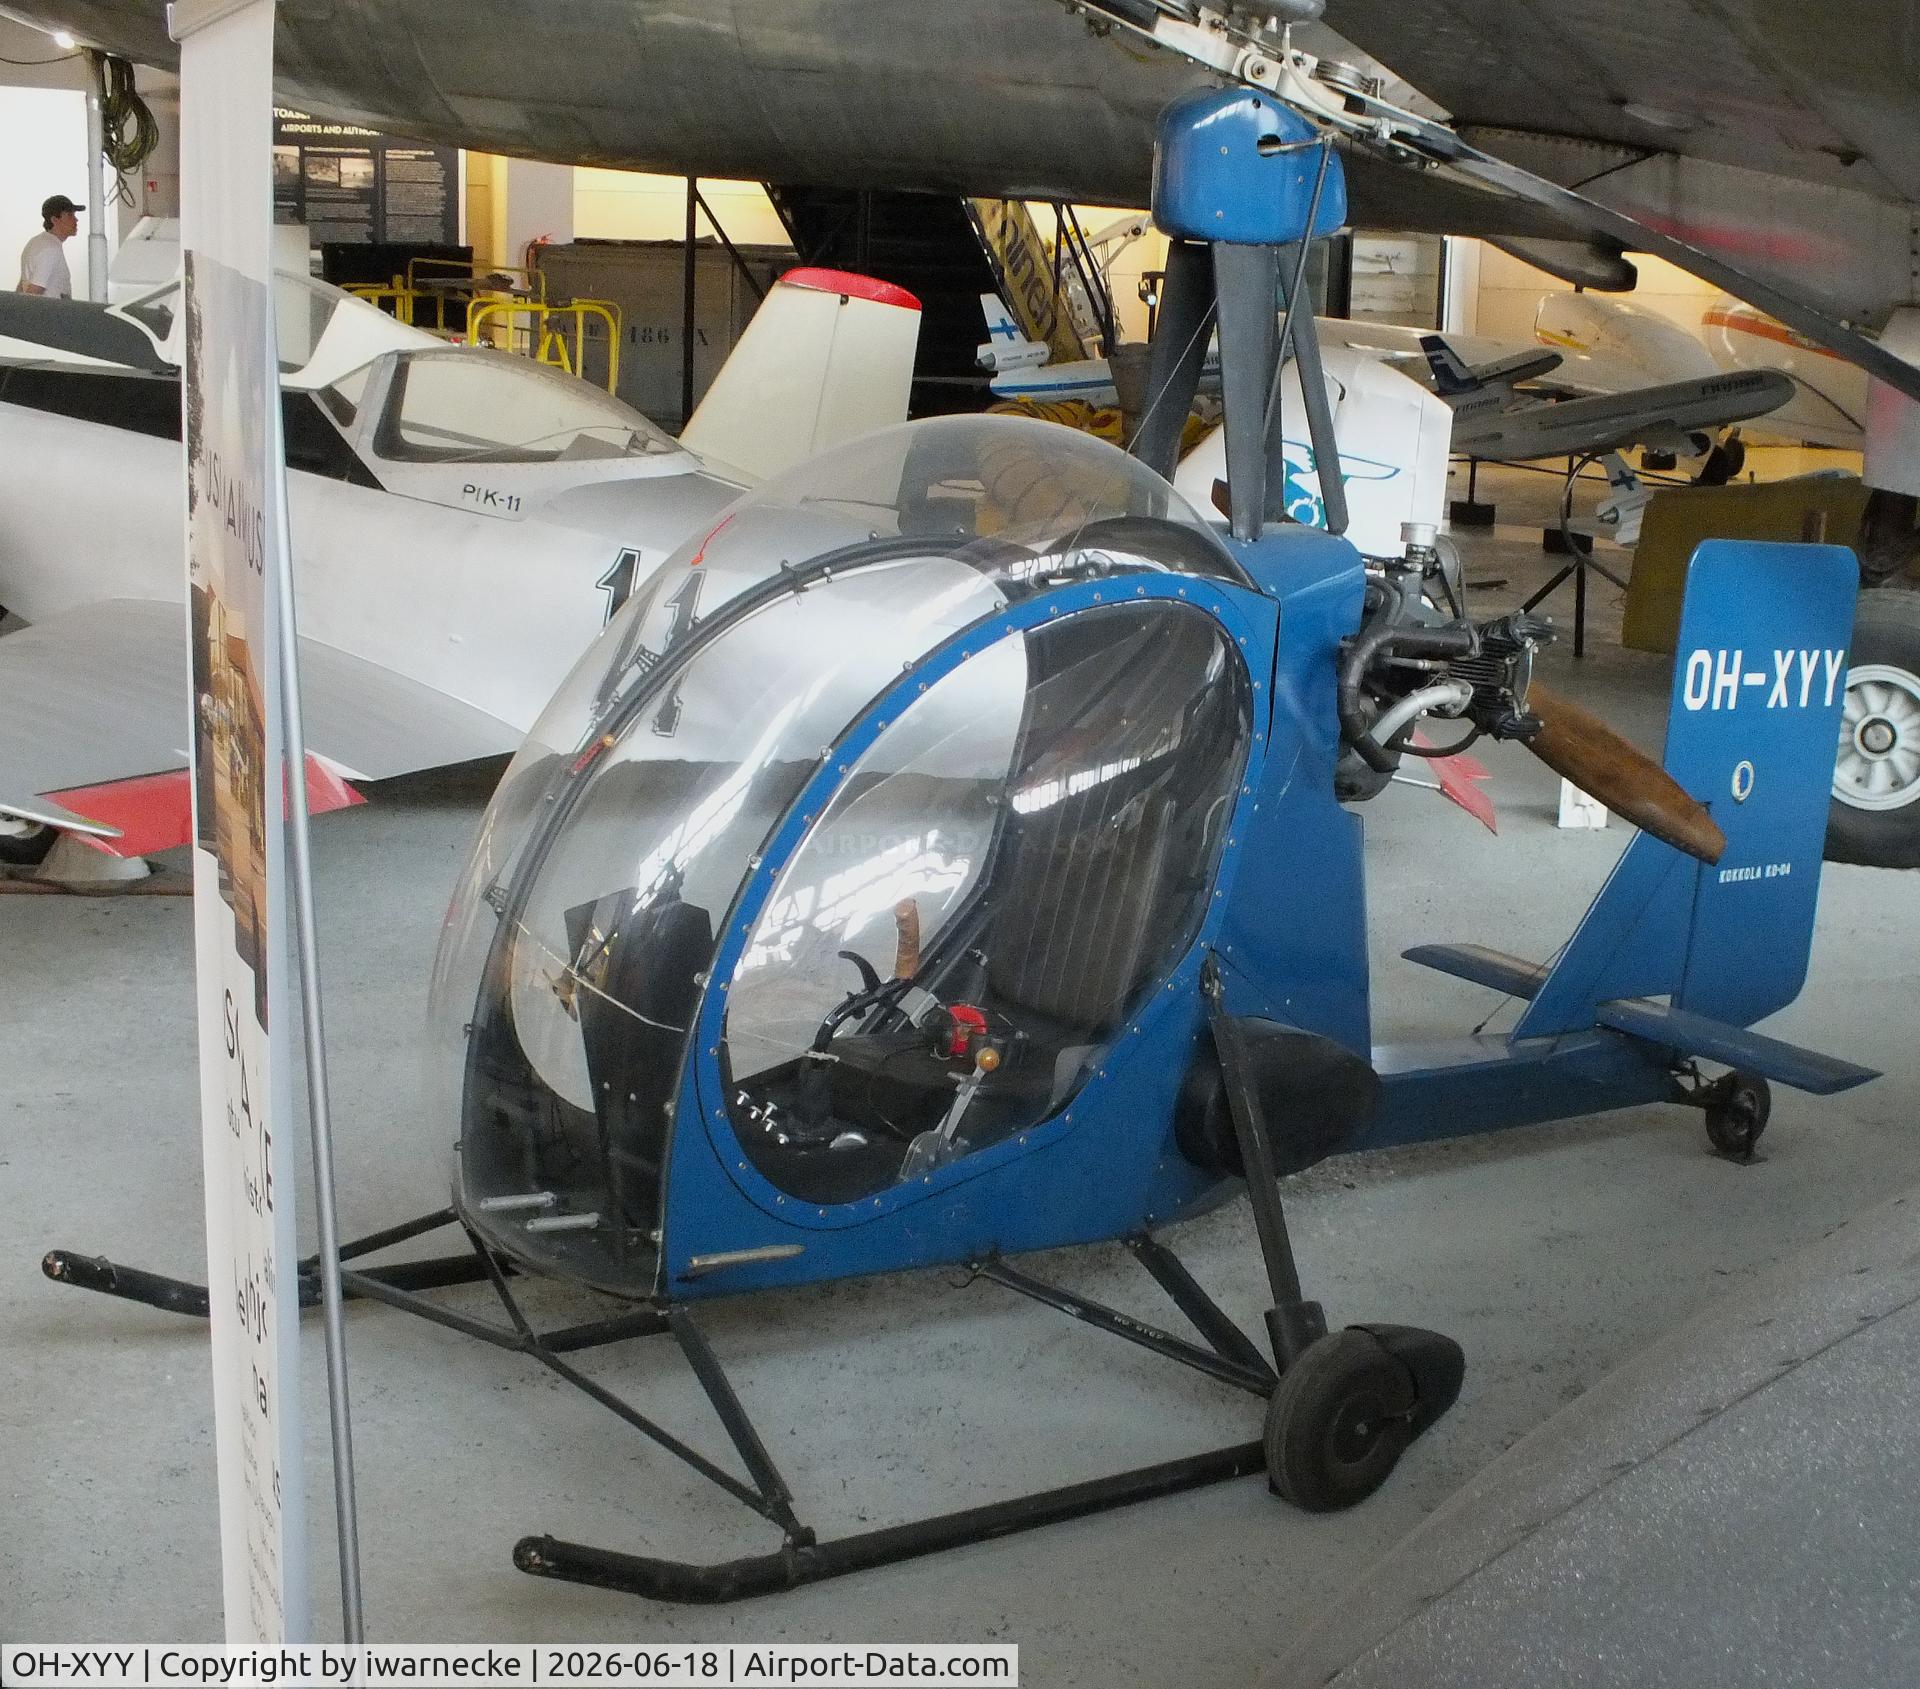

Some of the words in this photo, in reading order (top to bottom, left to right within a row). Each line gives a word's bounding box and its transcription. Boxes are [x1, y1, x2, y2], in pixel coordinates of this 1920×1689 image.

[281, 123, 322, 134] AIRPORTS
[323, 125, 342, 135] AND
[463, 484, 521, 512] PIK-11
[1683, 649, 1844, 711] OH-XYY
[1719, 865, 1762, 884] KOKKOLA
